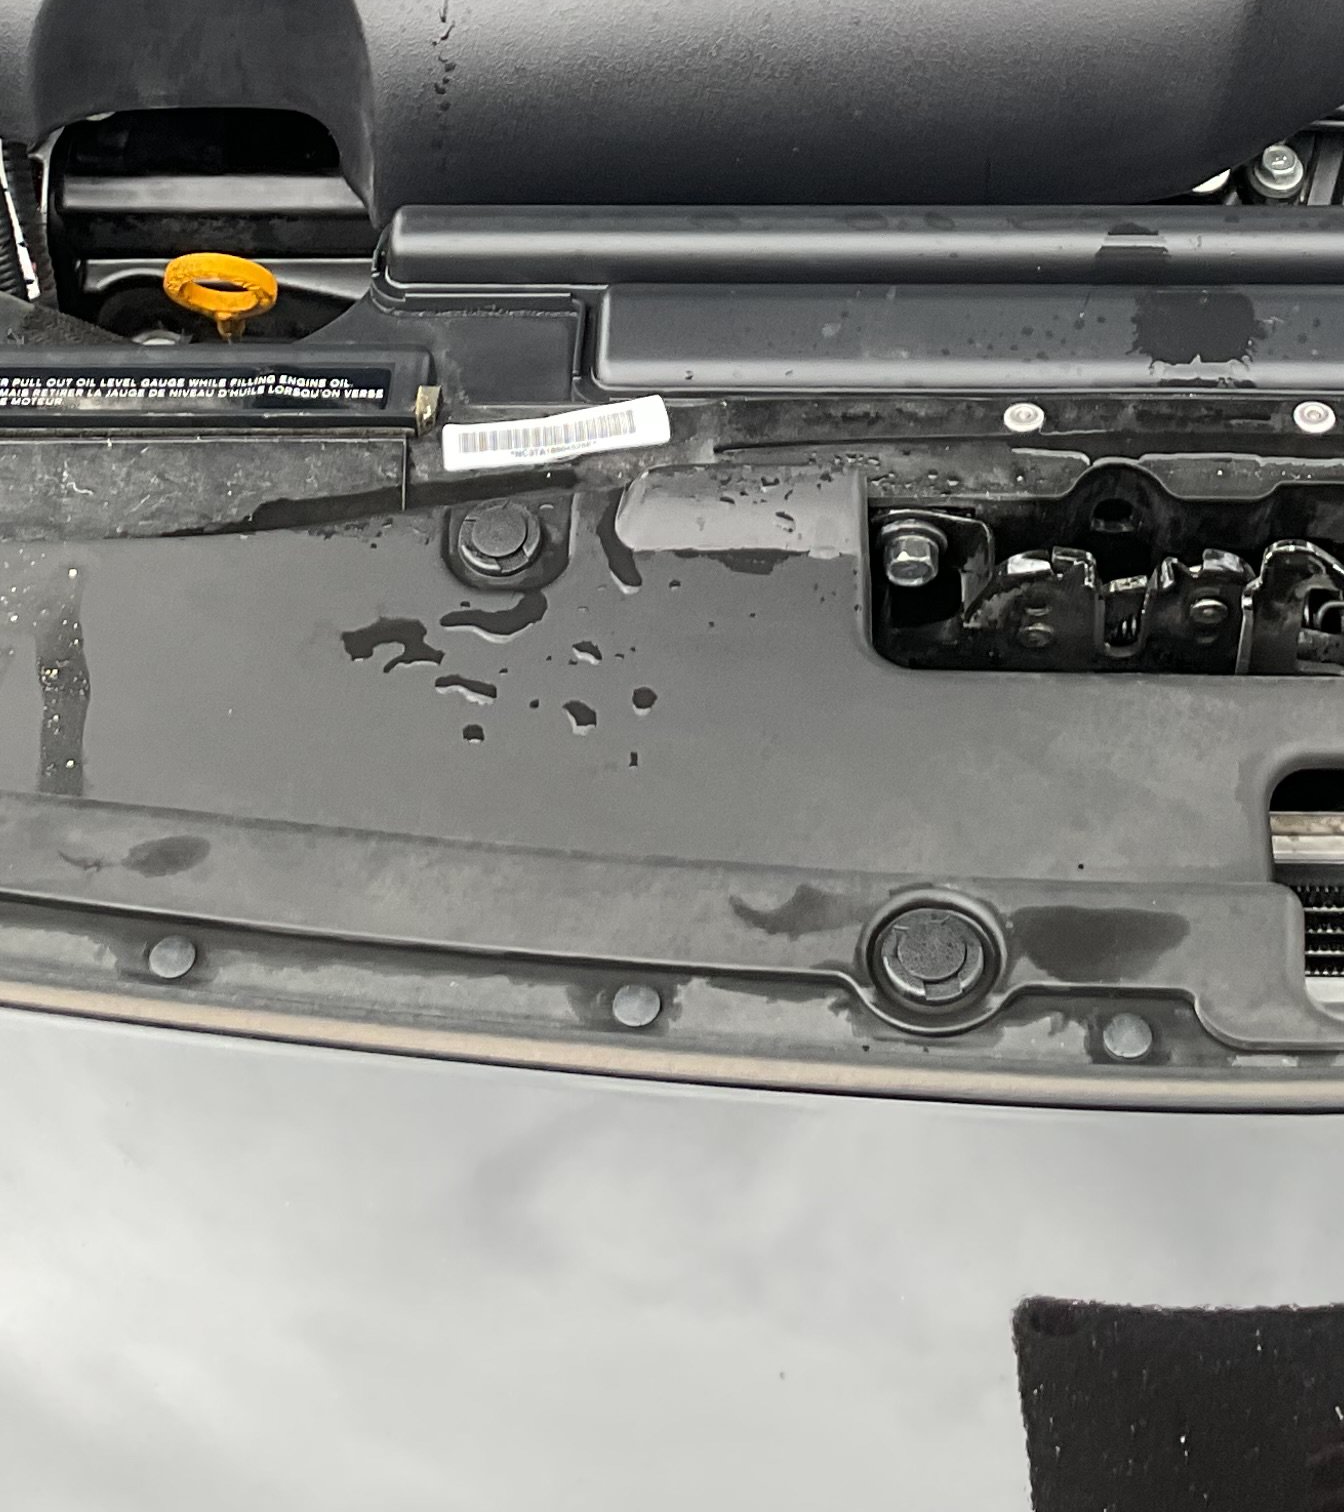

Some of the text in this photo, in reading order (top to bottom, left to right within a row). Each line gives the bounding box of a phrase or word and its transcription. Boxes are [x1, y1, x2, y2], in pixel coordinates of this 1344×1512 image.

[12, 377, 42, 388] PULL
[46, 377, 73, 388] OUT
[76, 377, 96, 388] OIL
[100, 377, 137, 388] LEVEL
[141, 377, 185, 388] GAUGE
[188, 377, 226, 388] WHILE
[229, 374, 276, 388] FILLING
[279, 374, 327, 388] ENGINE
[32, 388, 84, 397] RETIRER
[86, 388, 102, 397] LA
[105, 388, 145, 398] JAUGE
[149, 388, 166, 398] DE
[169, 388, 213, 398] NIVEAU
[218, 385, 265, 398] D'HUILE
[268, 385, 340, 399] LORSQU'ON
[343, 388, 384, 399] VERSE
